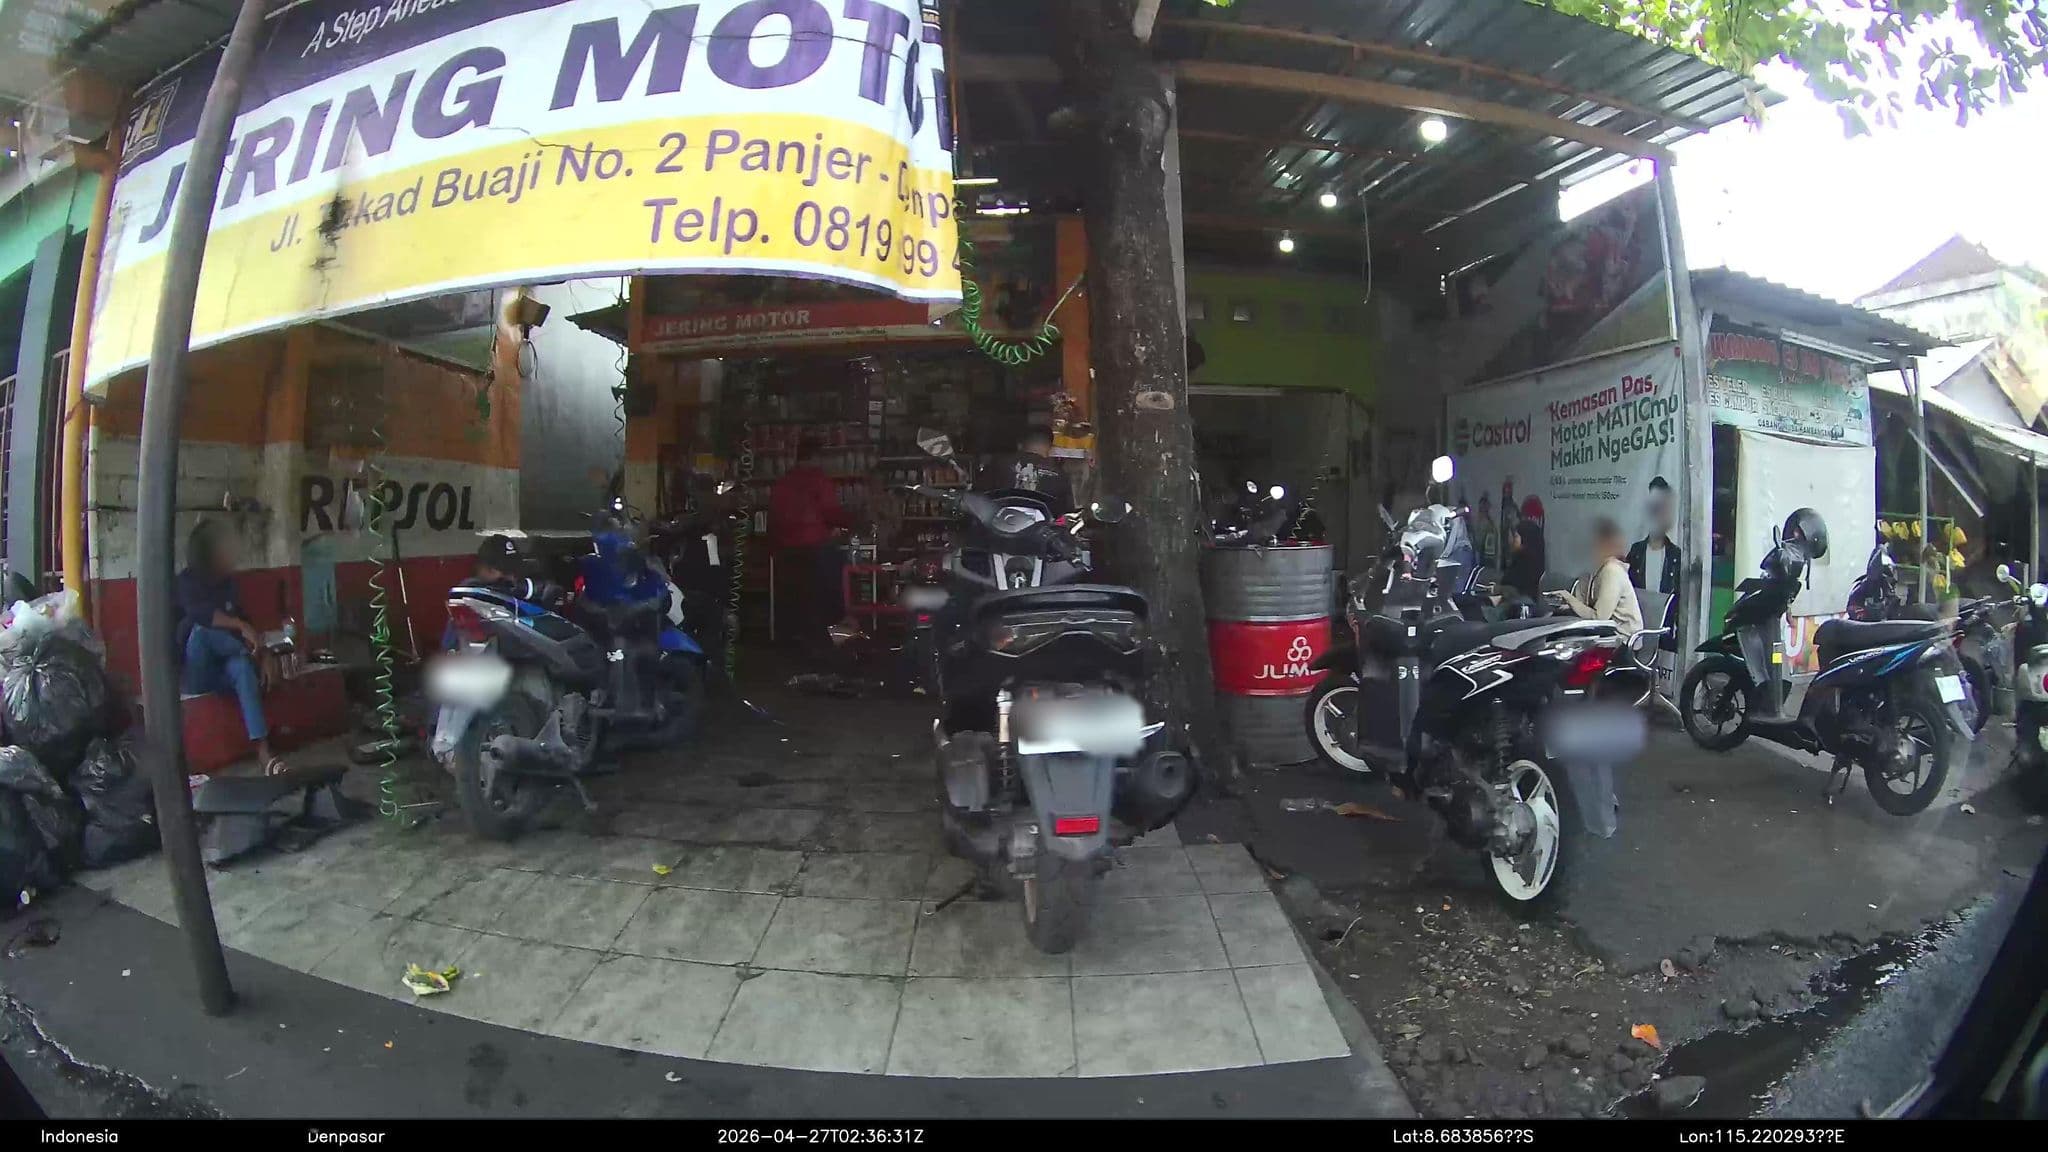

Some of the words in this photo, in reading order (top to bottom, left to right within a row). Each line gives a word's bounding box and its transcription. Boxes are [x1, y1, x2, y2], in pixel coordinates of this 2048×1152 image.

[301, 21, 325, 58] A
[325, 5, 382, 49] Step
[137, 46, 507, 245] JRING
[431, 151, 544, 208] Buaji
[555, 141, 634, 187] No.
[655, 131, 688, 175] 2
[704, 128, 873, 188] Panjer
[643, 195, 770, 255] Telp.
[793, 199, 892, 262] 0819
[735, 309, 811, 330] MOTOR
[1549, 385, 1617, 422] Kemasan
[1621, 374, 1658, 398] Pas,
[1550, 418, 1594, 446] Motor
[1596, 393, 1679, 433] MATICmu
[1472, 413, 1532, 448] Castrol
[1550, 443, 1594, 471] Makin
[1598, 418, 1676, 463] NgeGAS!
[1253, 662, 1311, 680] JUM
